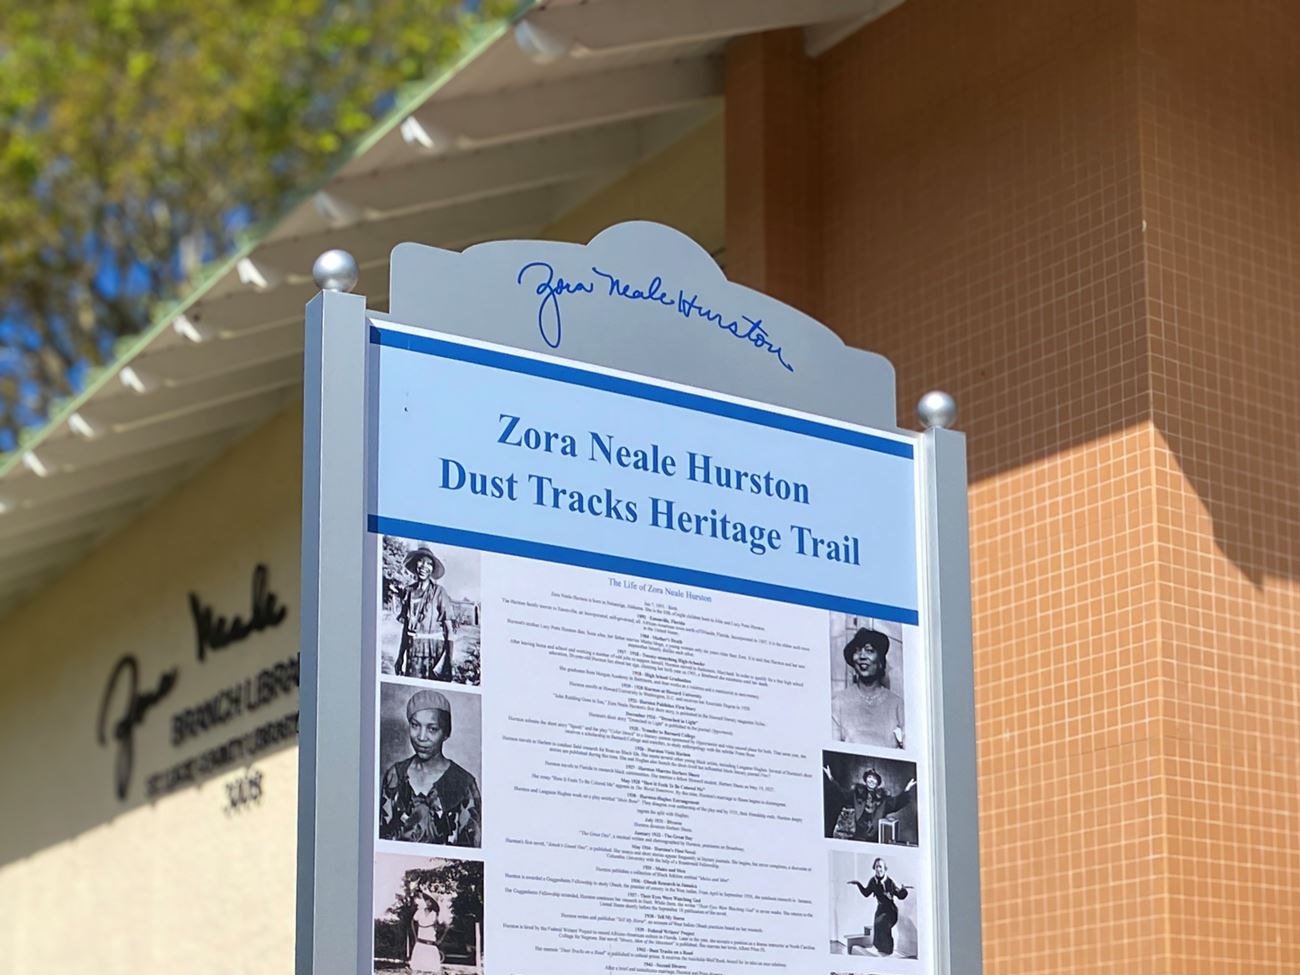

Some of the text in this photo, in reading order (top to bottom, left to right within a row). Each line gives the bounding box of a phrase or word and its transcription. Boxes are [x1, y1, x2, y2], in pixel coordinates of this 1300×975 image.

[518, 262, 796, 374] Zora Neale Hurston
[497, 413, 811, 506] Zora Neale Hurston
[438, 457, 861, 567] Dust Tracks Heritage Trail
[608, 577, 712, 603] The Life of Zora Neale Hurston
